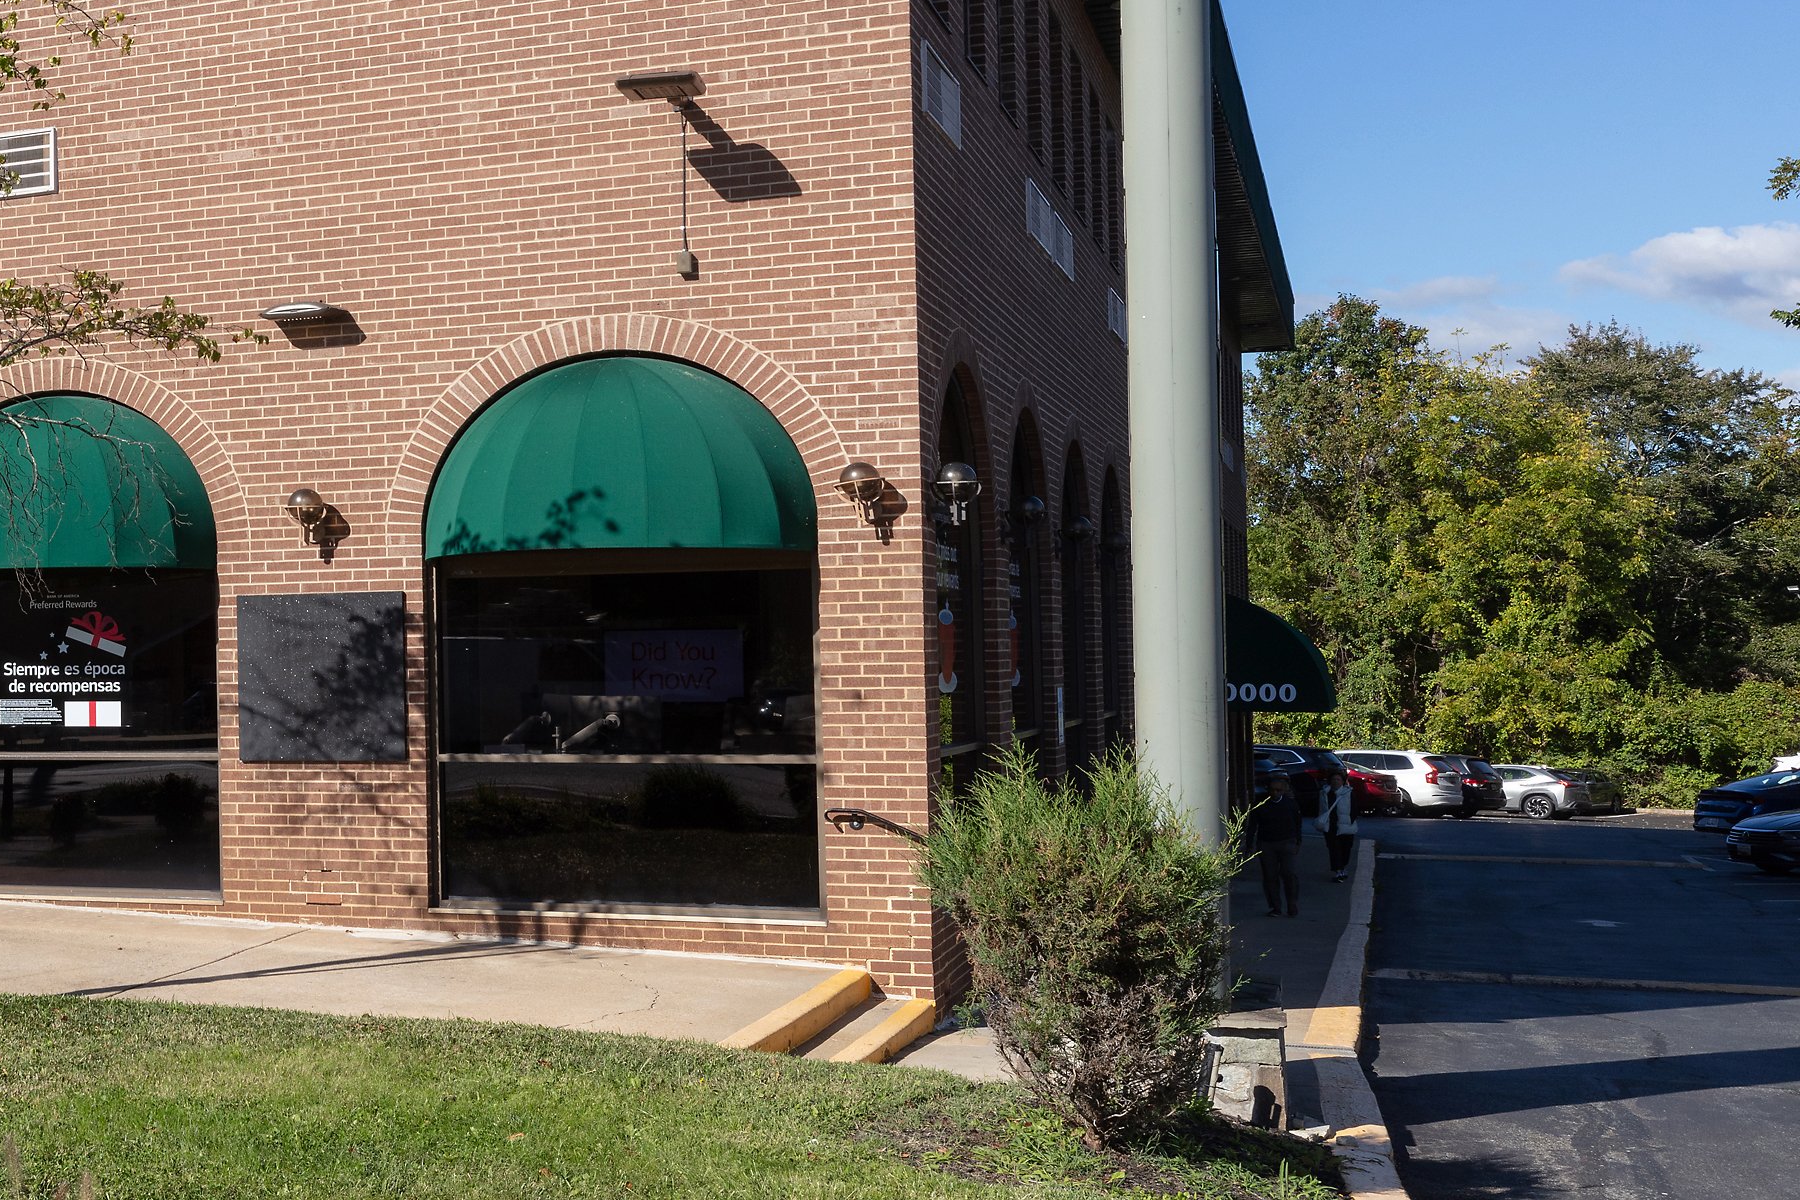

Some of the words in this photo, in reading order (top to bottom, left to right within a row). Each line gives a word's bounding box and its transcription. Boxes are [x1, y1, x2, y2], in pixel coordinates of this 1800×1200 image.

[29, 600, 64, 609] Preferred
[65, 600, 98, 609] Rewards
[631, 641, 666, 661] Did
[674, 641, 715, 661] You
[3, 662, 60, 679] Siempre
[64, 664, 80, 676] es
[84, 661, 126, 679] época
[631, 666, 717, 690] Know?
[8, 678, 26, 693] de
[29, 681, 121, 696] recompensas
